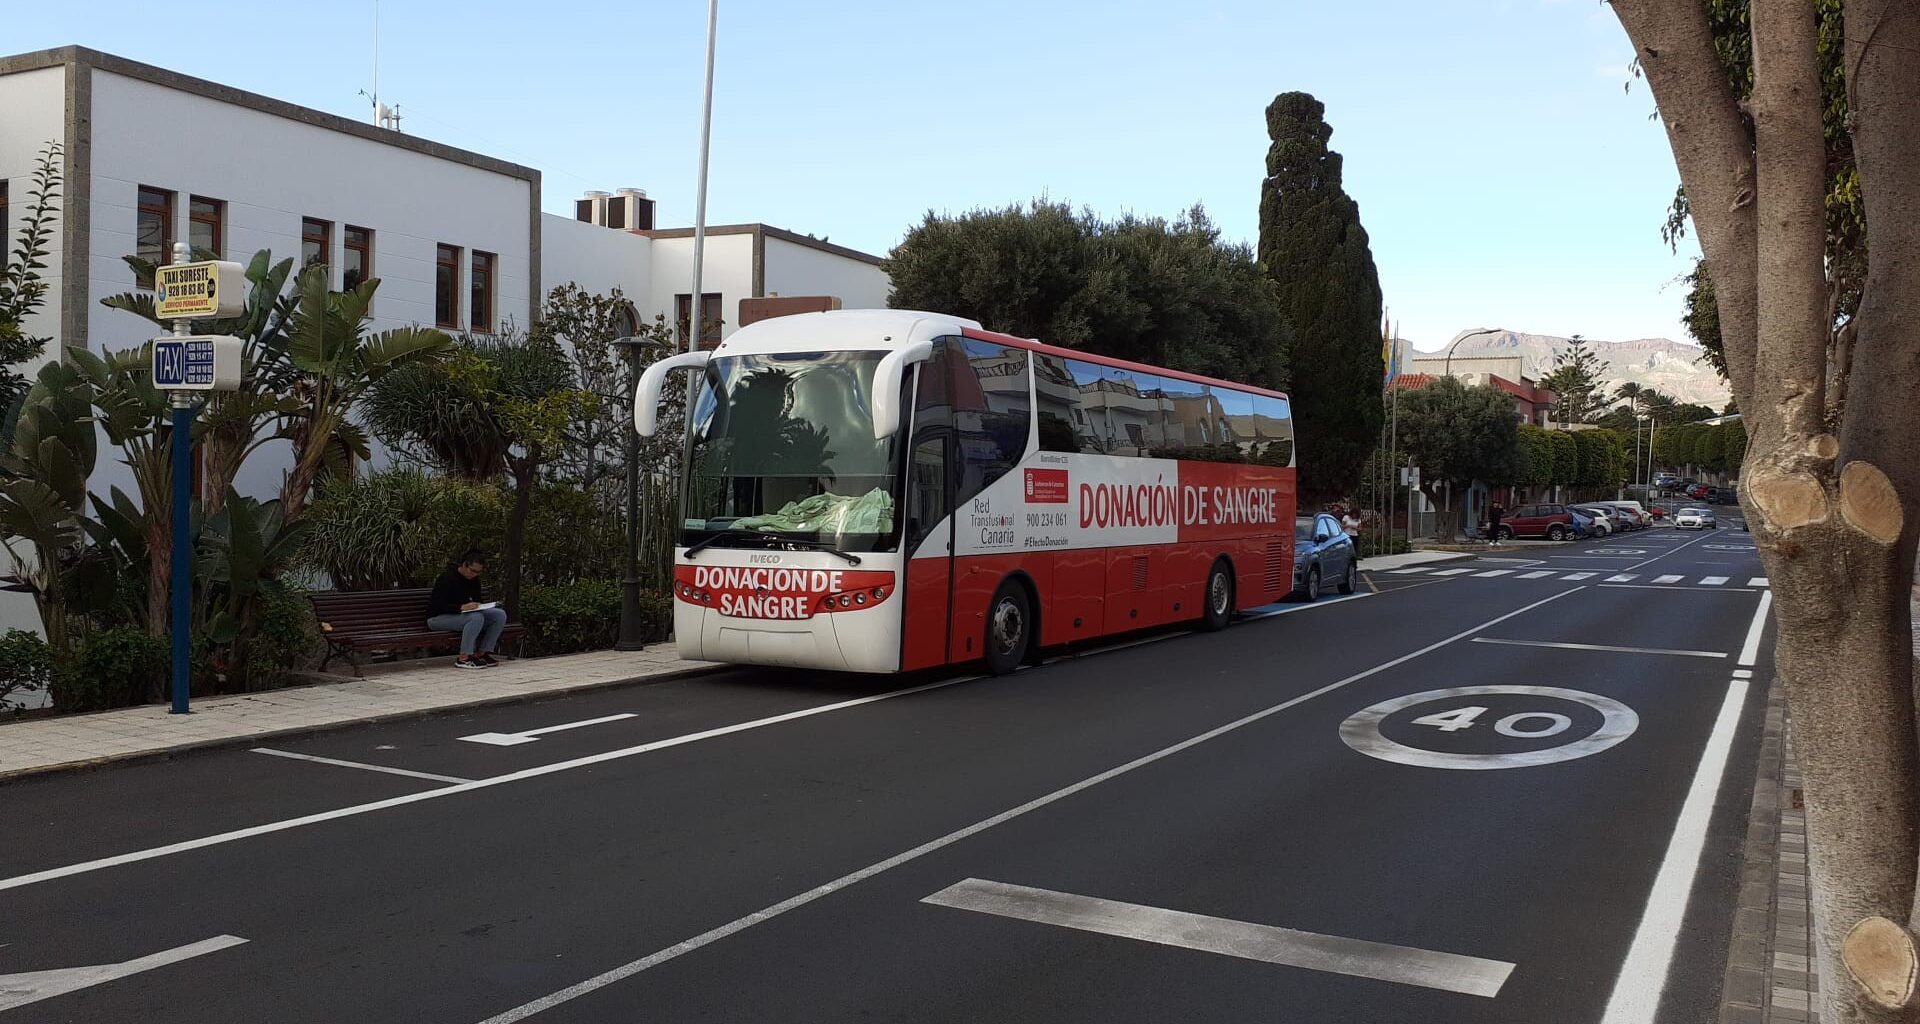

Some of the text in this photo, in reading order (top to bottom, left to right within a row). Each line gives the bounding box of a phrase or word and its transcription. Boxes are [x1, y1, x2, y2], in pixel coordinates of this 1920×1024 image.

[164, 268, 208, 284] TAXI SURESTE
[169, 285, 180, 297] 928
[181, 284, 188, 296] 18
[166, 299, 208, 308] SERVICIO PERMANENTE
[157, 346, 182, 380] TAXI
[974, 497, 990, 514] Red
[1080, 473, 1276, 529] DONACIÓN DE SANGRE
[970, 513, 1014, 528] Transfusional
[1026, 513, 1067, 527] 900 234 061
[981, 527, 1014, 544] Canaria
[750, 554, 780, 564] IVECO
[695, 567, 843, 592] DONACION DE
[720, 594, 808, 618] SANGRE
[1411, 706, 1572, 738] 40
